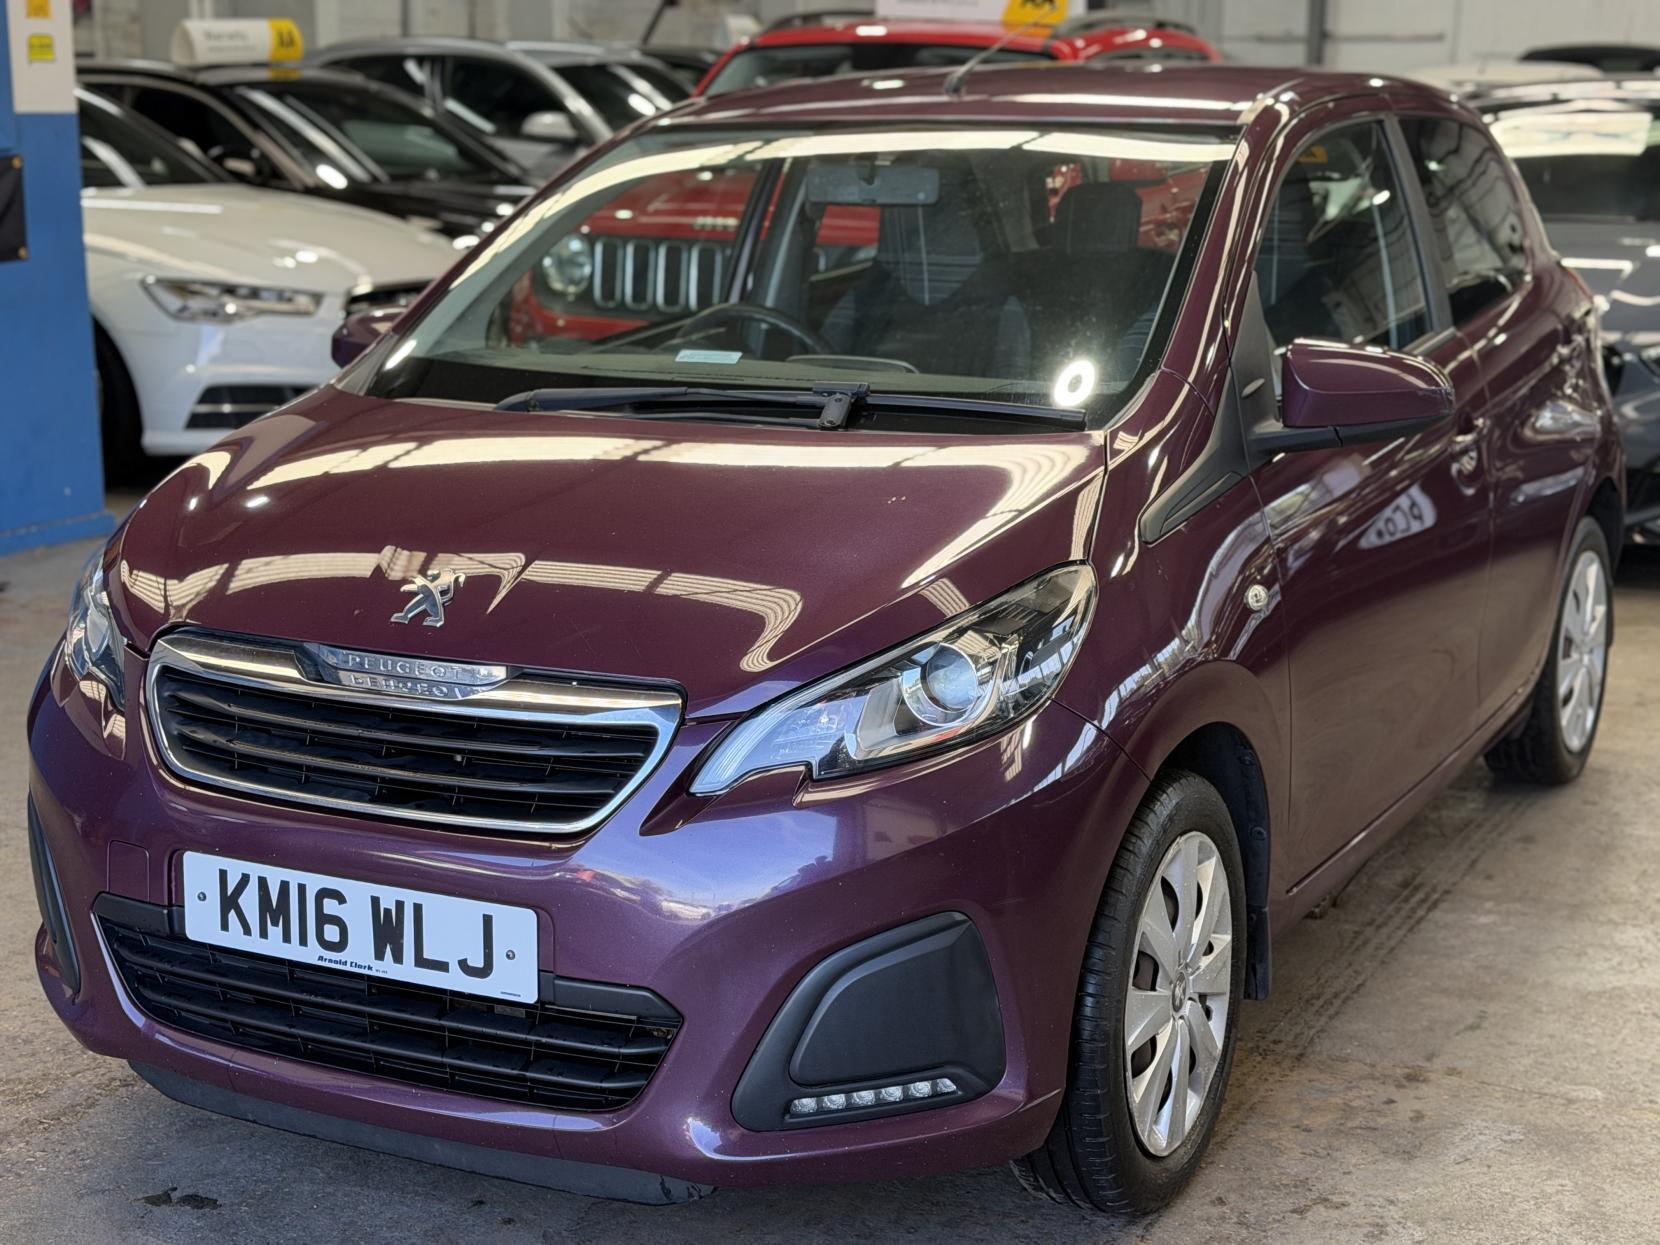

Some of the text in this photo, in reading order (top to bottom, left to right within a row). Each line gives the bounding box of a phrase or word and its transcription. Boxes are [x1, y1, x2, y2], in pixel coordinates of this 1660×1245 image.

[348, 653, 463, 680] PEUGEOT
[218, 868, 494, 980] KM16 WLJ
[317, 955, 348, 967] Arnold
[349, 960, 374, 972] Clark
